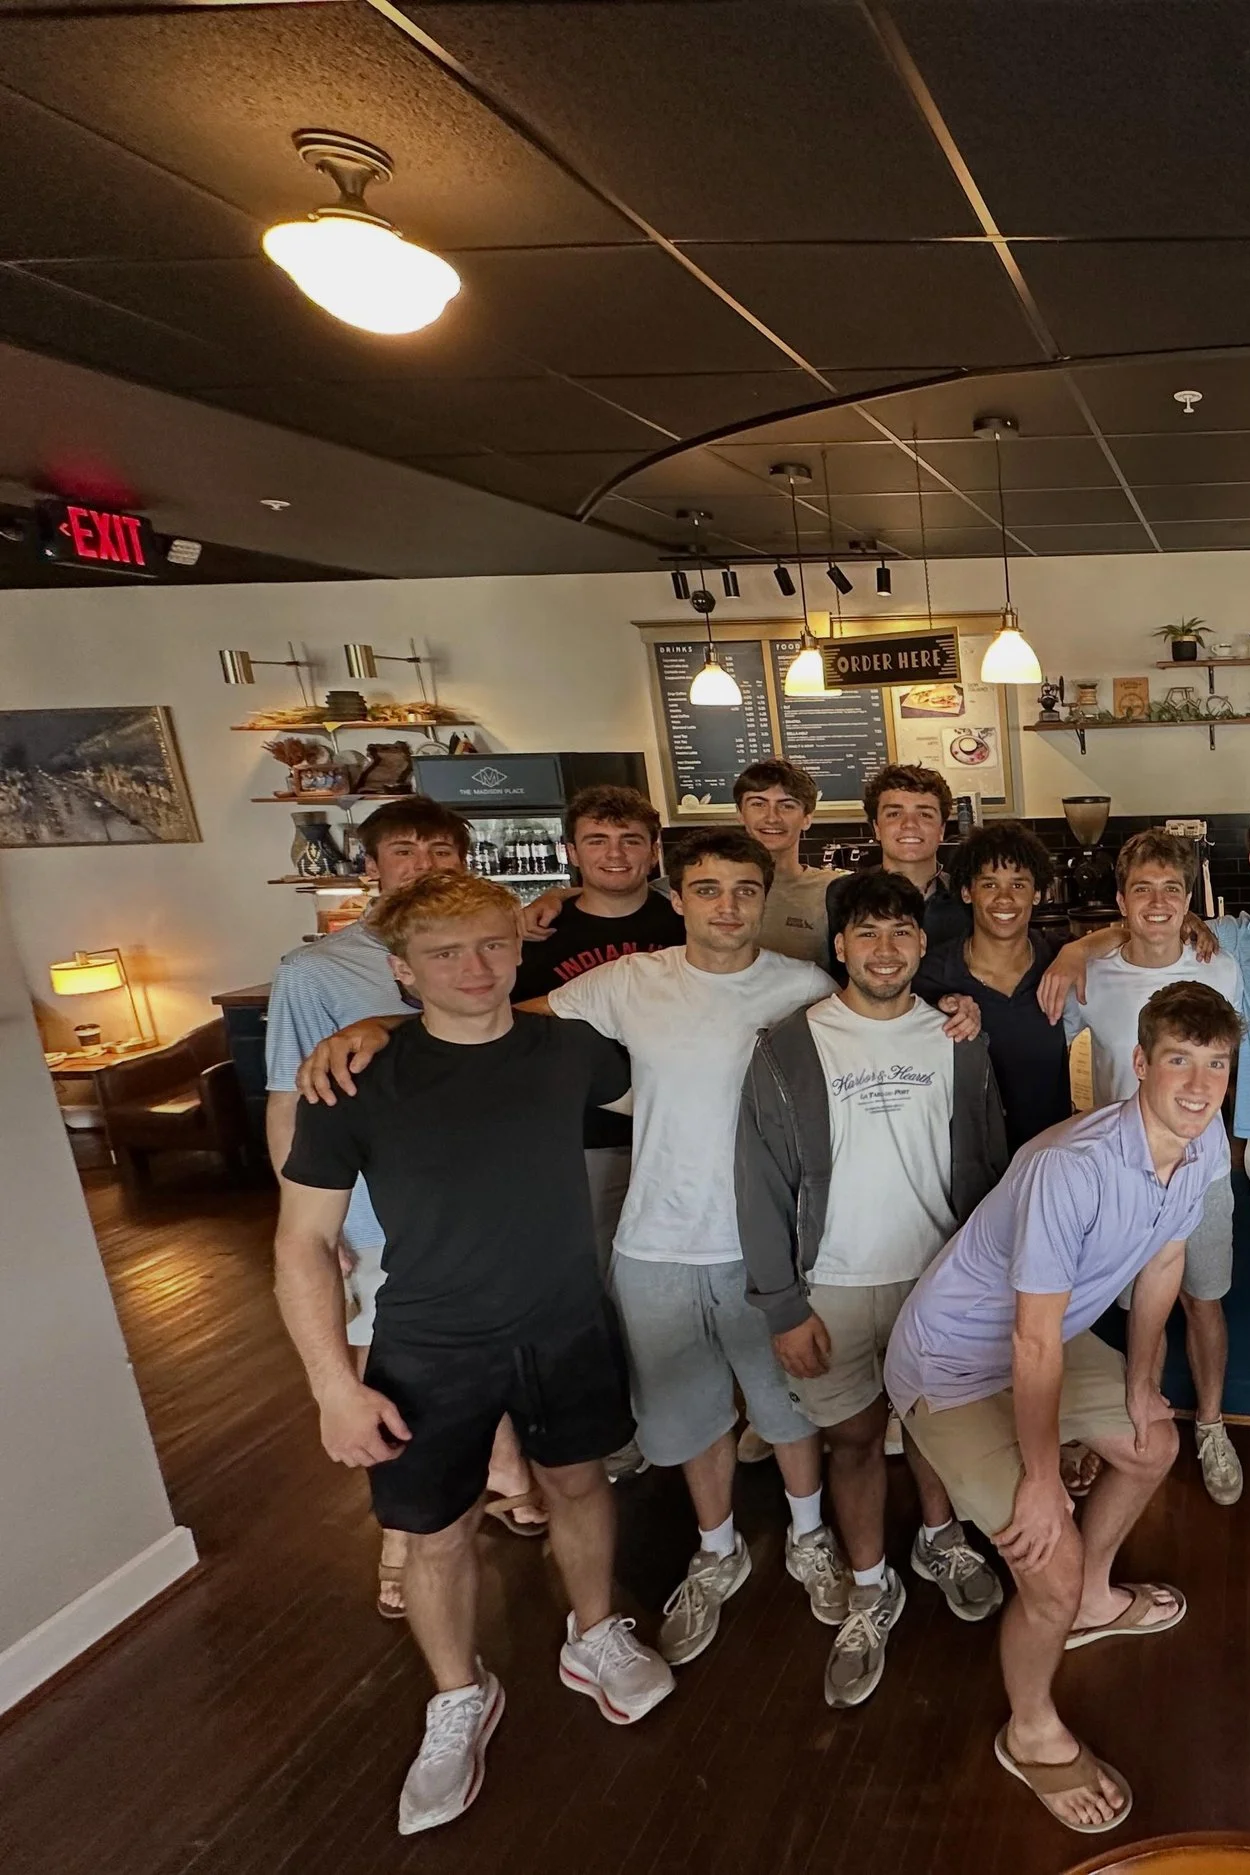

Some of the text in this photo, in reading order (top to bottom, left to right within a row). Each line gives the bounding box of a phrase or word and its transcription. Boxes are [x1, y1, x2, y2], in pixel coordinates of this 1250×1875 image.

[67, 506, 145, 566] EXIT
[660, 646, 693, 654] DRINKS
[837, 649, 941, 673] ORDER HERE
[553, 942, 638, 981] INDIAN
[888, 1064, 936, 1086] Hearth
